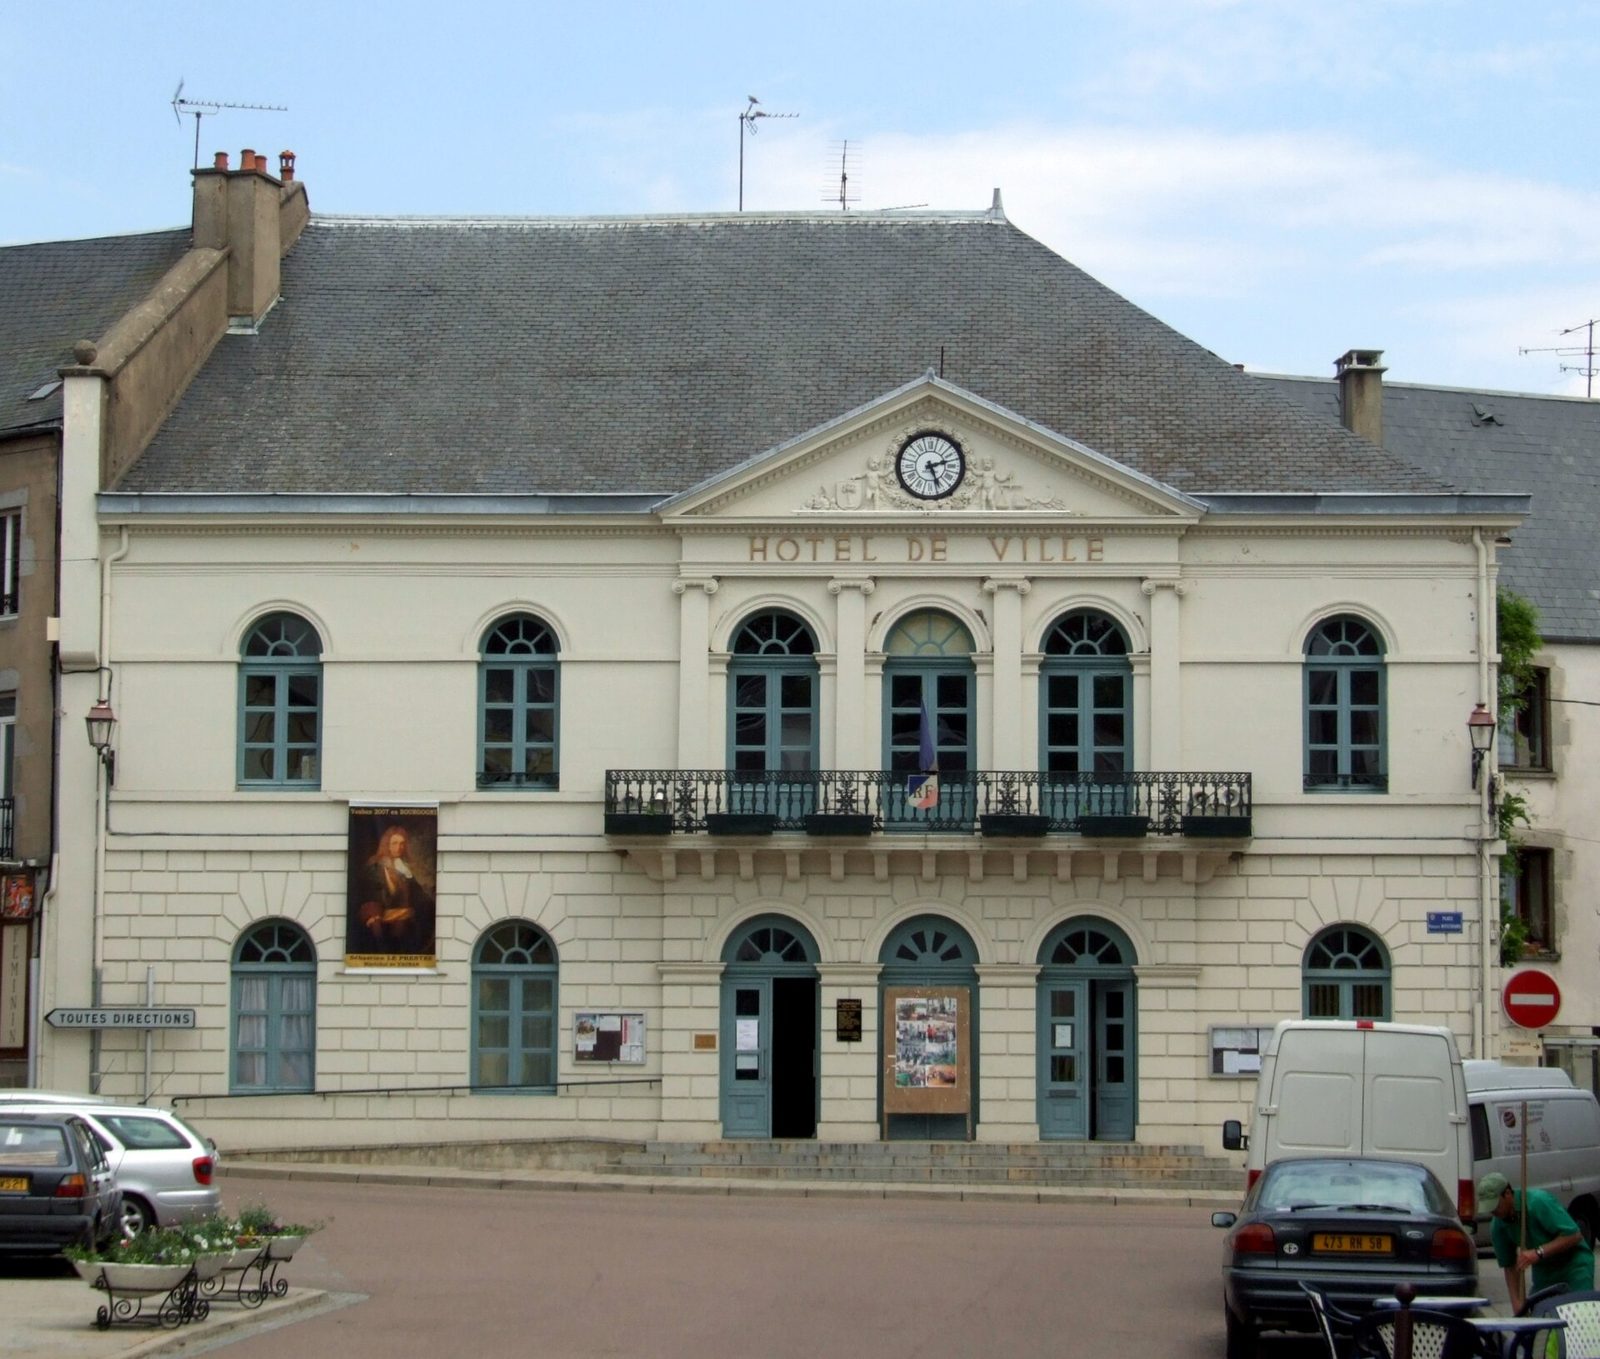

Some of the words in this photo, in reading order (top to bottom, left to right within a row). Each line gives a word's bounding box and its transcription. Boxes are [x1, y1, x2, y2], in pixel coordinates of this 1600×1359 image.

[749, 536, 878, 562] HOTEL
[907, 536, 948, 562] DE
[987, 536, 1104, 562] VILLE
[913, 784, 933, 799] RF
[374, 808, 389, 816] 2007
[60, 1013, 107, 1024] TOUTES
[113, 1013, 190, 1024] DIRECTIONS
[1322, 1233, 1343, 1249] 473
